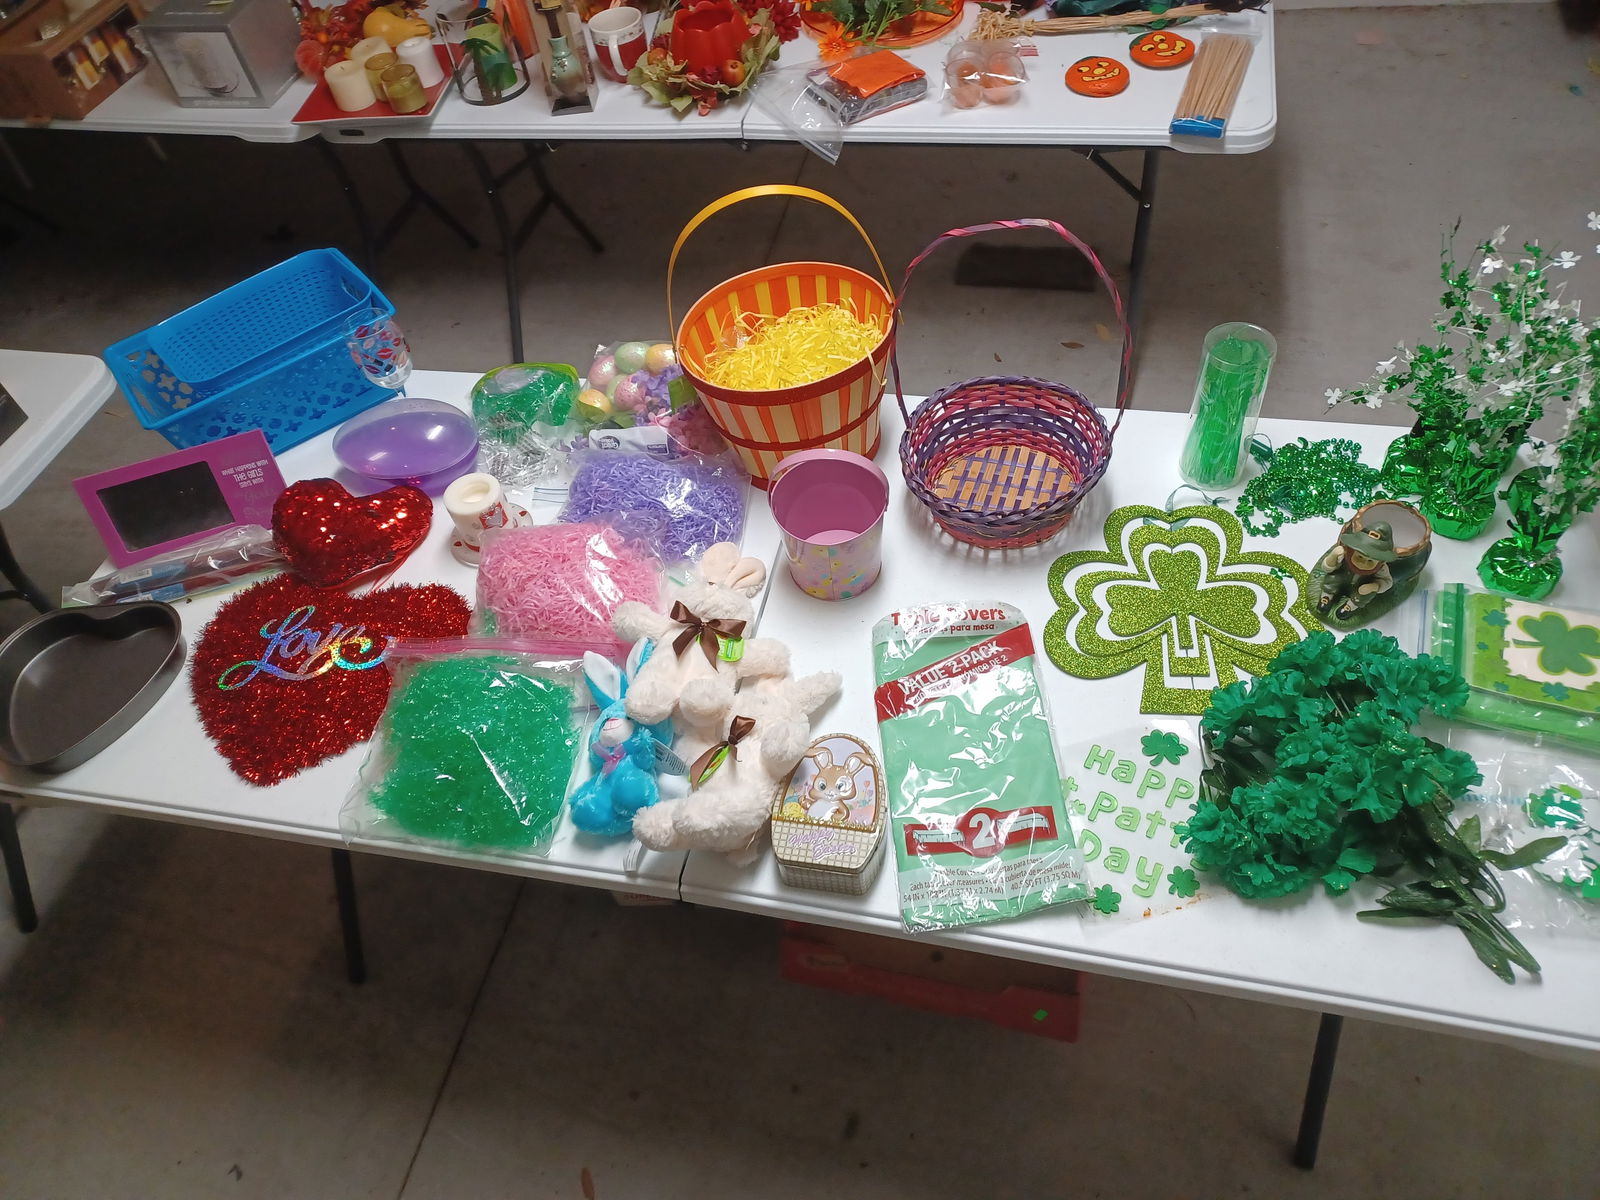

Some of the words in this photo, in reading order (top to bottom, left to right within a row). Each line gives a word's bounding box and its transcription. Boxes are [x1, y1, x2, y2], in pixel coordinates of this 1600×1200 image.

[890, 608, 941, 627] Tble
[946, 604, 1006, 622] overs
[950, 624, 972, 635] para
[972, 622, 995, 631] mesa
[218, 605, 392, 690] Love
[1000, 654, 1008, 662] 2
[897, 667, 949, 695] VALUE
[969, 812, 996, 849] 2
[1079, 828, 1164, 898] Day
[956, 877, 984, 886] measures
